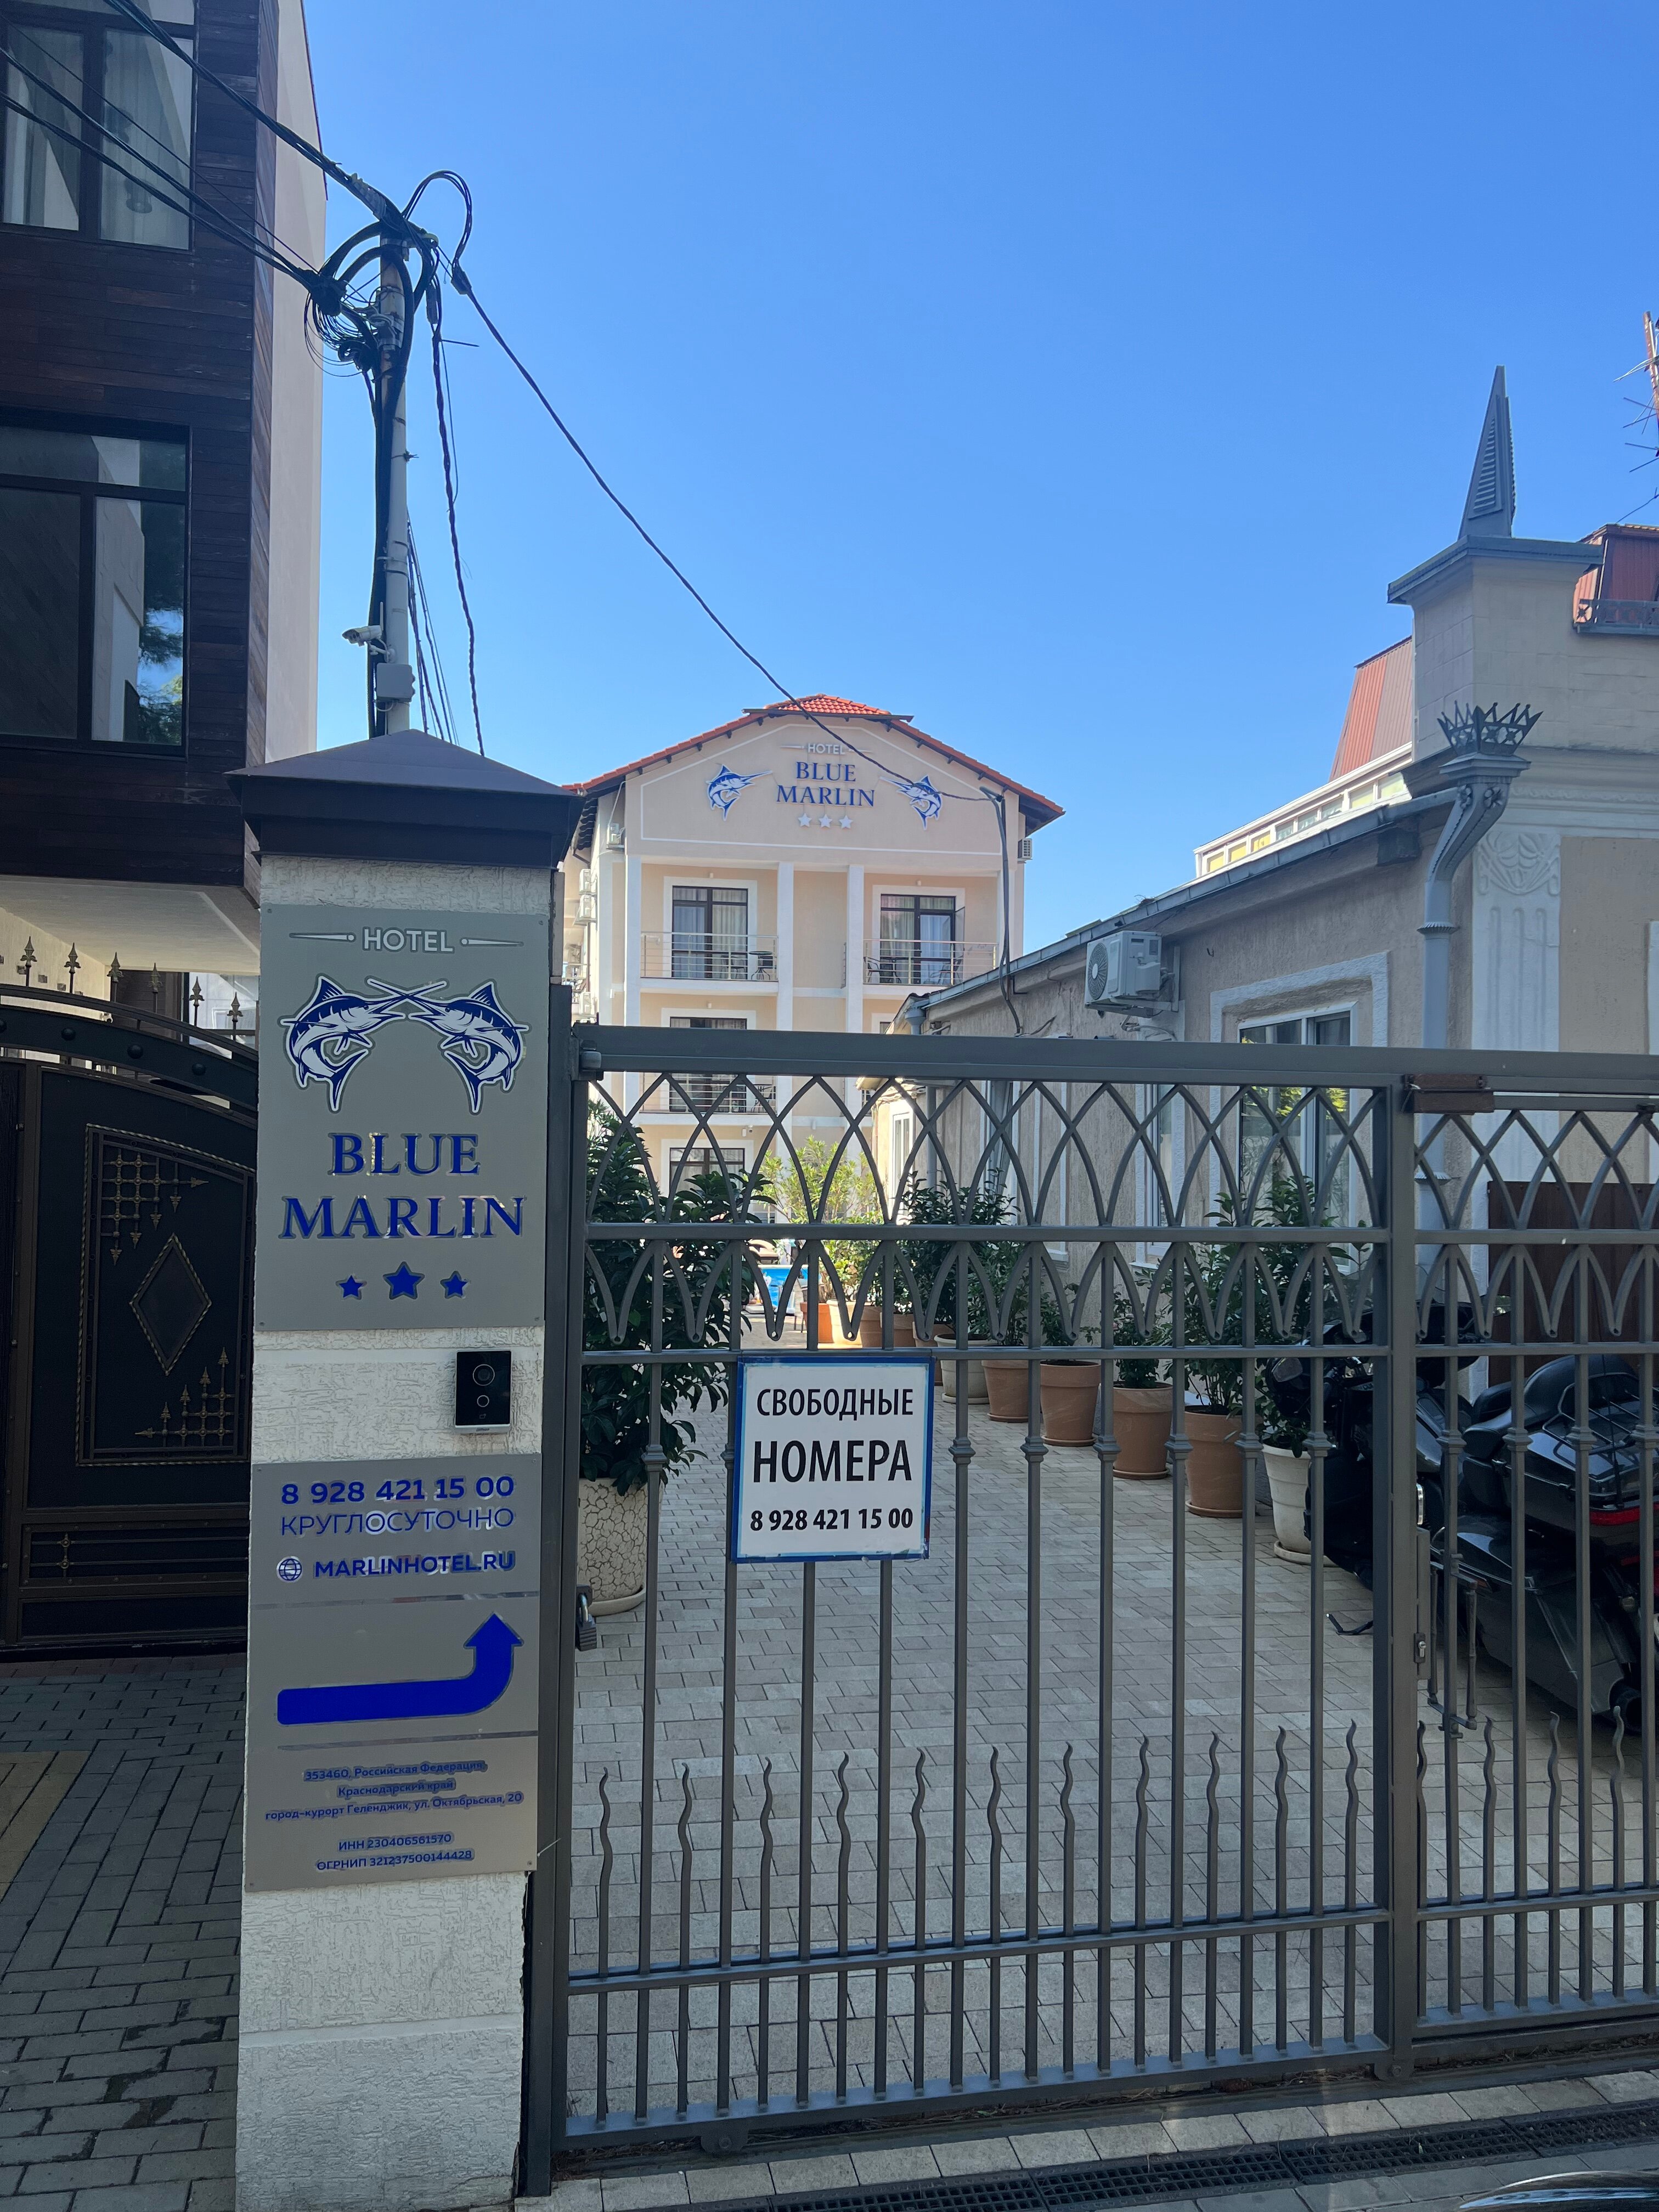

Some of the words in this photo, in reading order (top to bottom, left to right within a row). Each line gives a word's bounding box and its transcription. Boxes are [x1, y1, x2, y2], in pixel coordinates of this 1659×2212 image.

[808, 743, 846, 755] HOTEL
[796, 761, 856, 782] BLUE
[776, 785, 874, 807] MARLIN
[363, 928, 454, 953] HOTEL
[330, 1133, 481, 1176] BLUE
[280, 1195, 525, 1239] MARLIN
[757, 1388, 913, 1421] СВОБОДНЫЕ
[753, 1440, 912, 1483] НОМЕРА
[281, 1483, 299, 1504] 8
[311, 1481, 365, 1504] 928
[375, 1479, 425, 1502] 421
[436, 1477, 465, 1499] 15
[476, 1476, 515, 1497] 00
[281, 1508, 515, 1536] КРУГЛОСУТОЧНО
[750, 1510, 764, 1531] 8
[769, 1509, 808, 1531] 928
[812, 1509, 849, 1530] 421
[858, 1508, 882, 1529] 15
[888, 1508, 913, 1528] 00
[315, 1551, 516, 1577] MARLINHOTEL.RU
[305, 1769, 351, 1781] 353460,
[354, 1765, 417, 1777] Российская
[338, 1783, 425, 1798] Краснодарский
[427, 1780, 454, 1792] край
[266, 1807, 345, 1821] город-курорт
[347, 1803, 411, 1814] Геленджик,
[414, 1802, 430, 1811] ул.
[433, 1795, 505, 1808] Октябрьская,
[507, 1792, 522, 1802] 20
[338, 1840, 364, 1850] ИНН
[368, 1834, 452, 1848] 230406561570
[317, 1858, 366, 1871] ОГРНИП
[370, 1850, 472, 1866] 321237500144428
